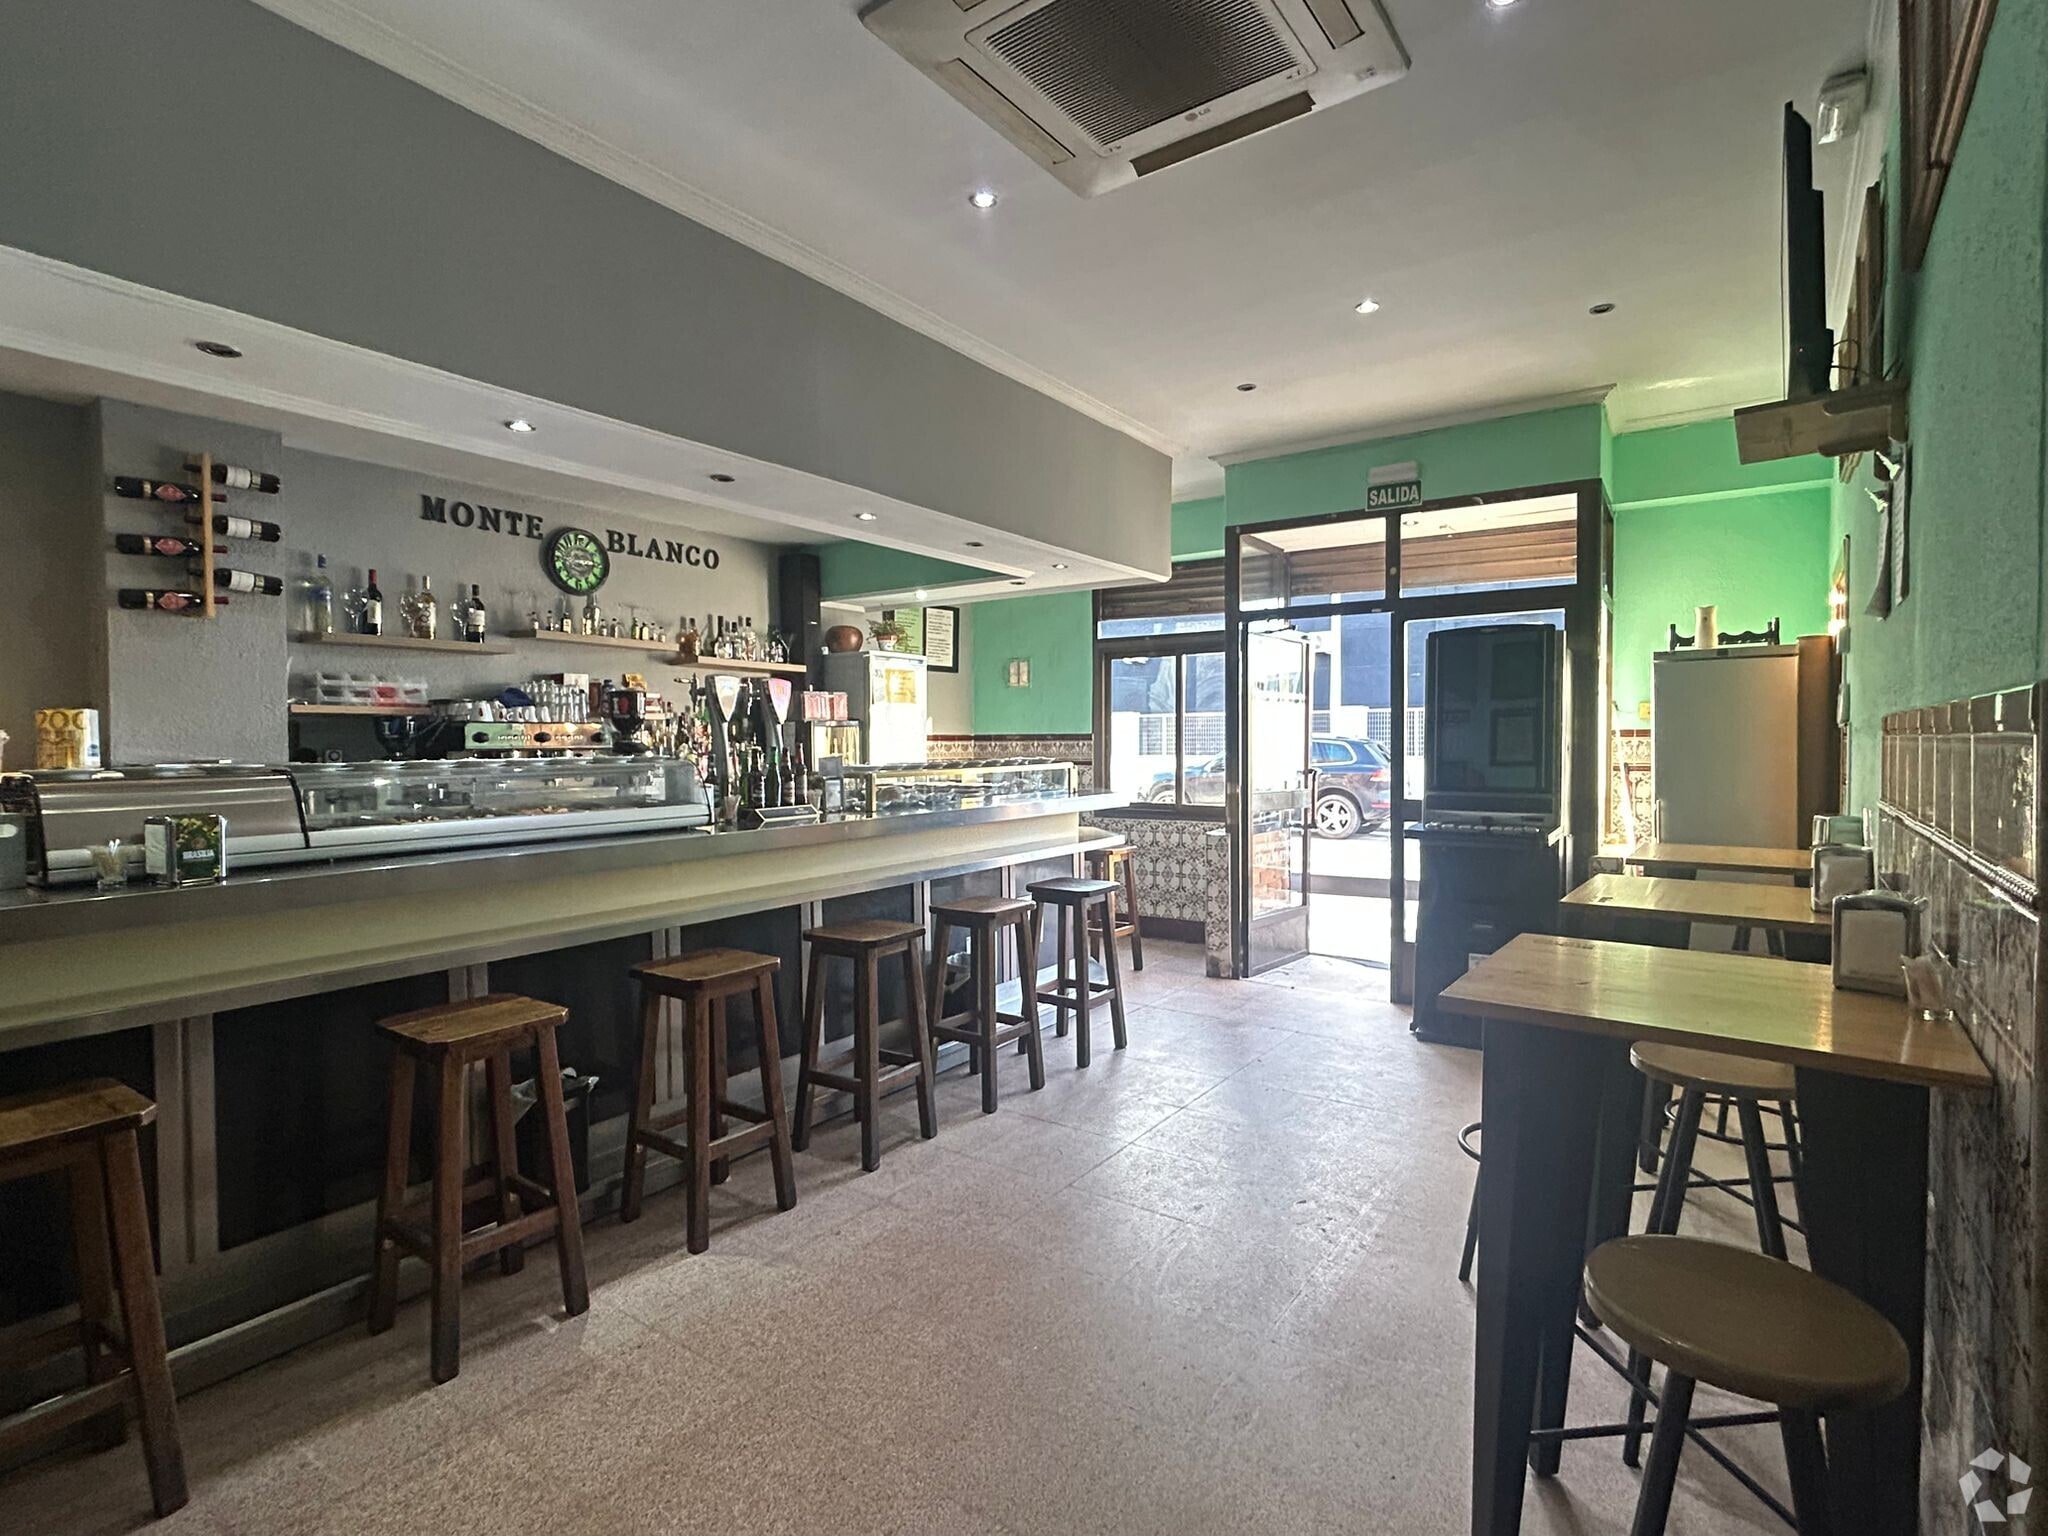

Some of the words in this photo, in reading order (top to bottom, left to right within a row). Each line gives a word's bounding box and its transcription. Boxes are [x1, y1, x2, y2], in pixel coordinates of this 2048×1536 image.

[1369, 484, 1419, 506] SALIDA
[420, 494, 543, 540] MONTE
[606, 529, 720, 570] BLANCO
